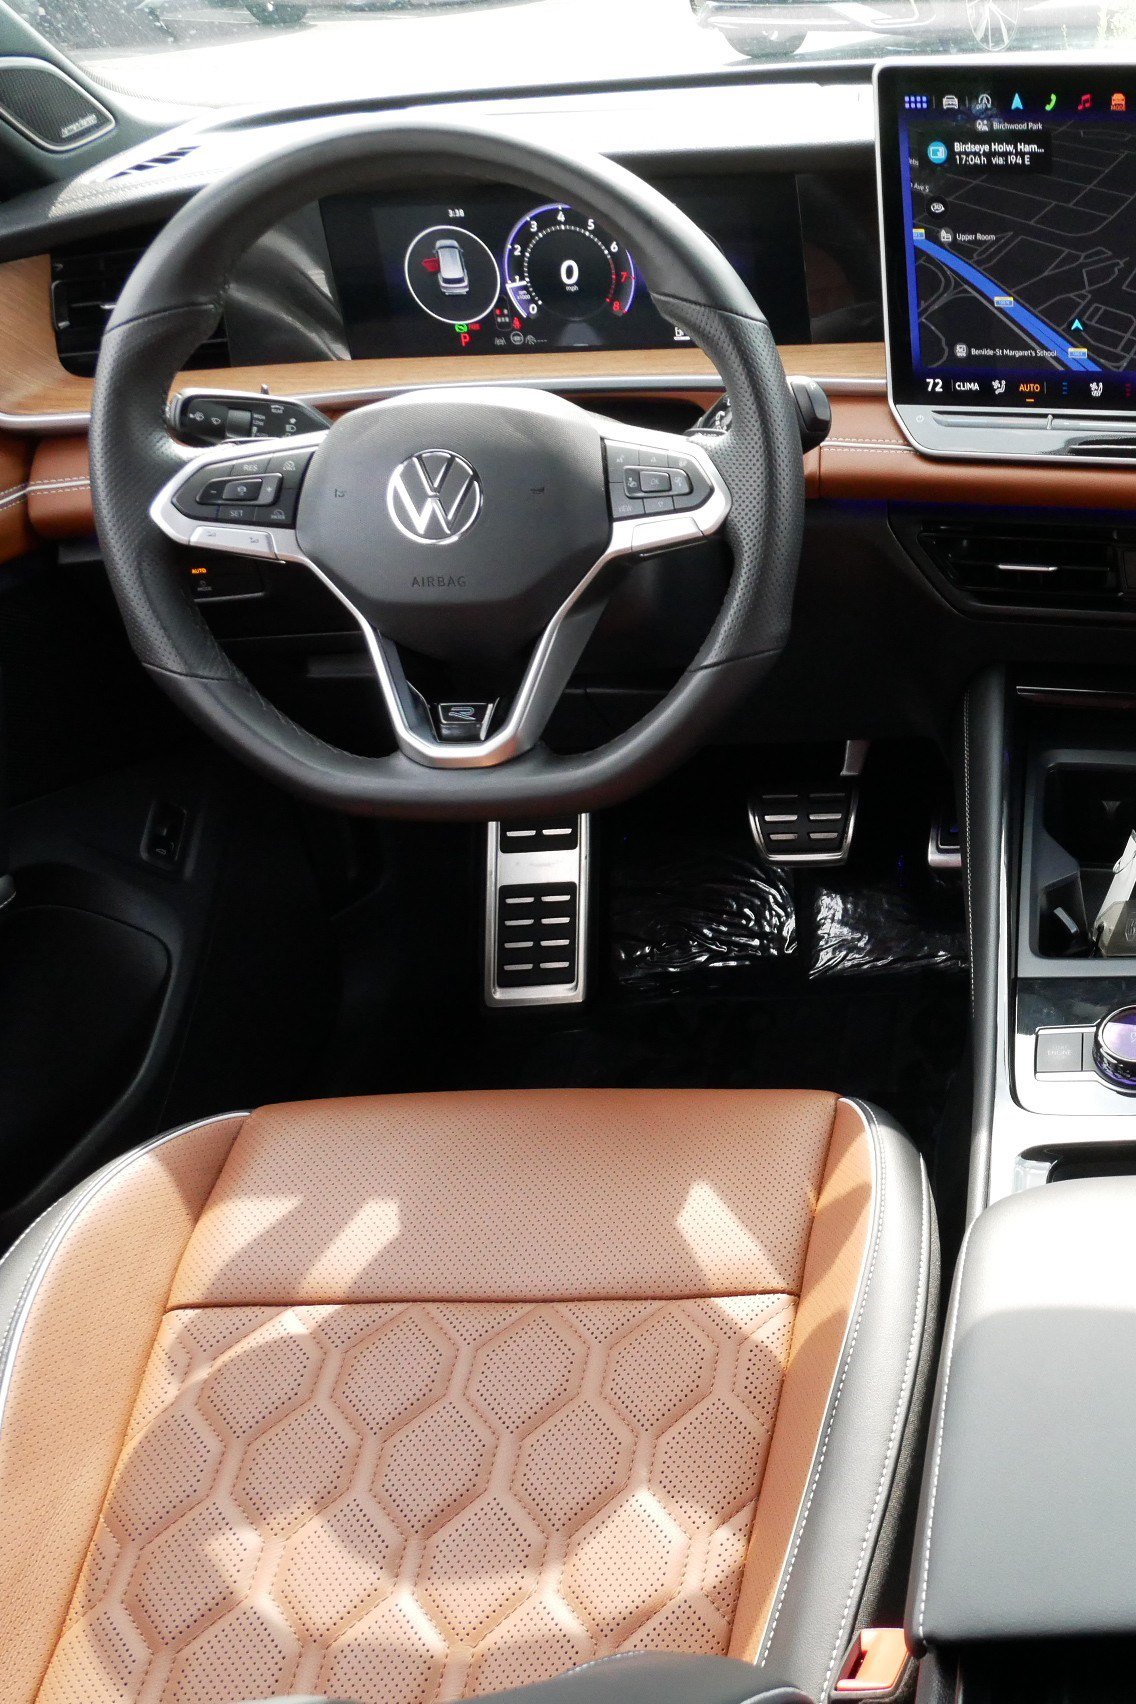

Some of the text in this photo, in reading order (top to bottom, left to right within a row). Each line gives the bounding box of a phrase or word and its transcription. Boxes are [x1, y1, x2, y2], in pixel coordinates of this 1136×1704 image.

[993, 121, 1043, 130] Birchwood Park
[954, 142, 1045, 153] Birdseye Holw, Ham...
[991, 155, 1006, 165] via:
[1024, 155, 1031, 165] E
[448, 208, 465, 218] 3:38
[557, 211, 565, 222] 4
[530, 221, 538, 232] 3
[587, 219, 595, 230] 5
[956, 233, 996, 241] Upper Room
[514, 244, 522, 256] 2
[610, 241, 619, 252] 6
[560, 259, 579, 285] 0
[621, 272, 628, 282] 7
[529, 303, 538, 314] 0
[612, 301, 620, 312] 8
[461, 333, 470, 347] P
[1003, 348, 1035, 358] Margaret's
[1036, 348, 1057, 357] School
[926, 378, 943, 392] 72
[955, 382, 980, 391] CLIMA
[1019, 383, 1040, 392] AUTO
[243, 464, 258, 472] RES
[230, 509, 243, 517] SET
[411, 575, 467, 588] AIRBAG
